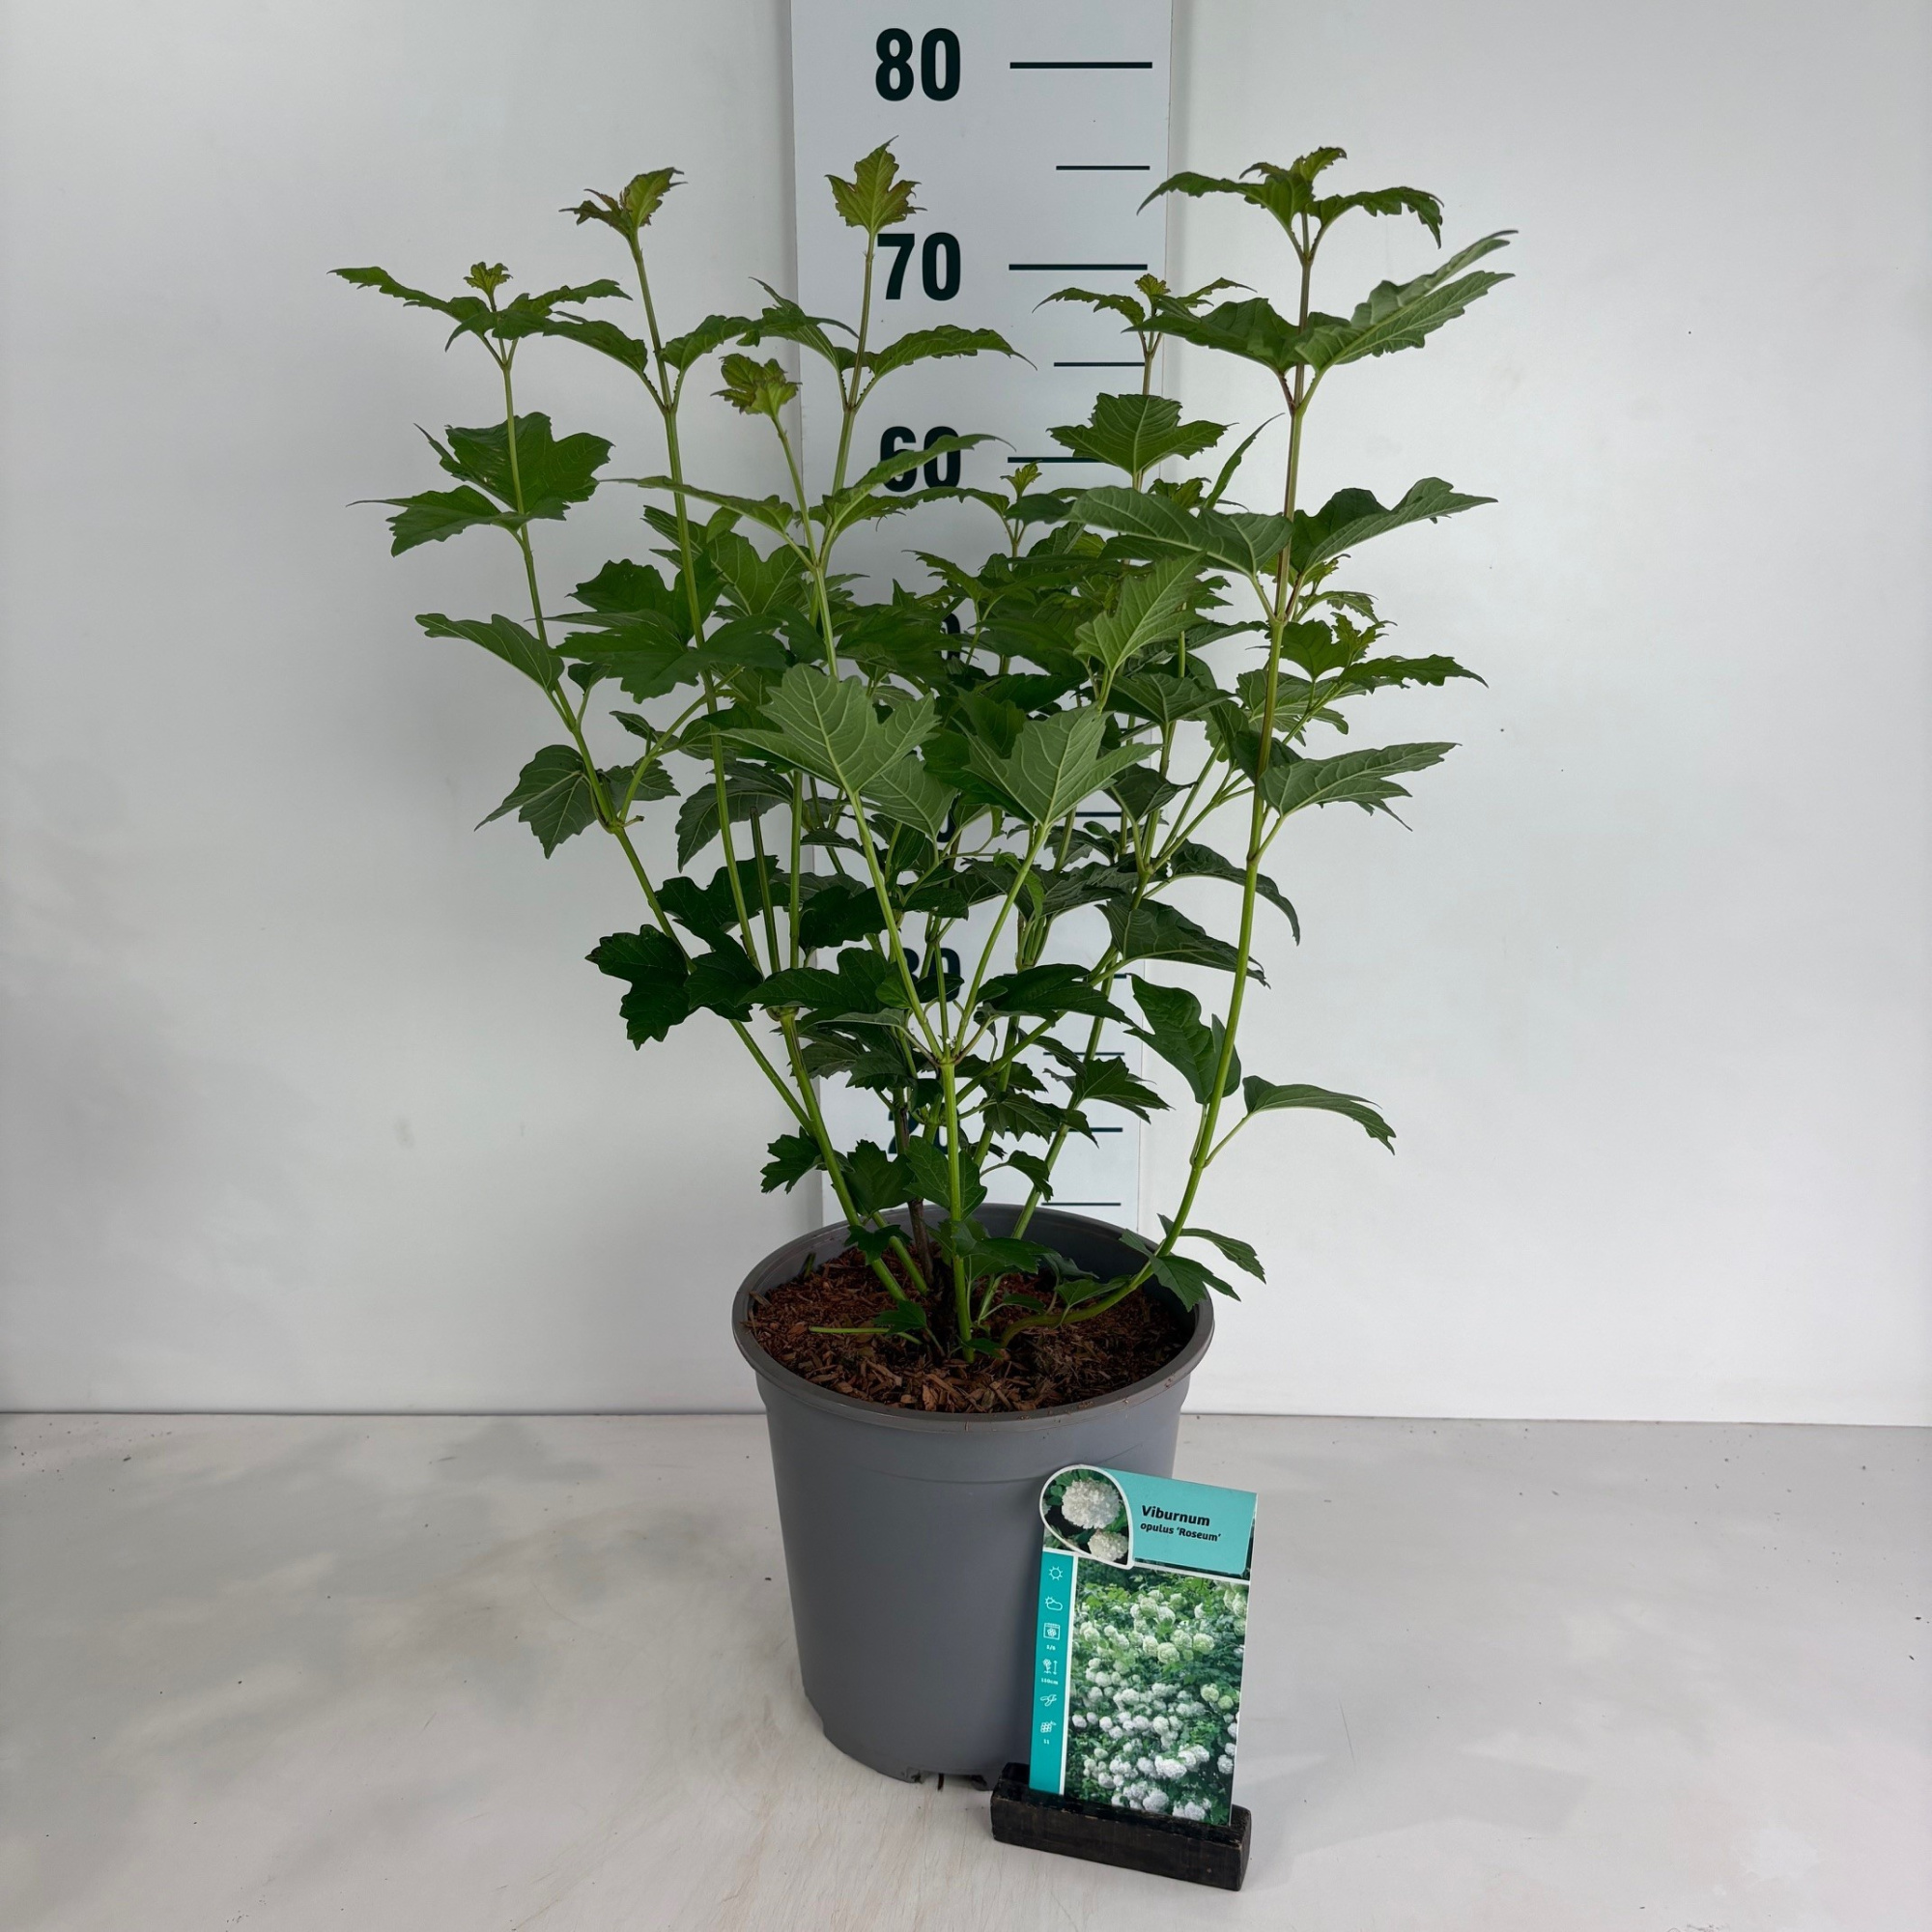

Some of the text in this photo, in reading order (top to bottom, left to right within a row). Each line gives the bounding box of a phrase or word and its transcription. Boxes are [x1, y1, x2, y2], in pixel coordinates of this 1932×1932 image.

[875, 27, 961, 101] 80
[877, 231, 961, 301] 70
[880, 426, 961, 493] 60
[1140, 1522, 1175, 1534] opulus
[1142, 1504, 1210, 1526] Viburnum
